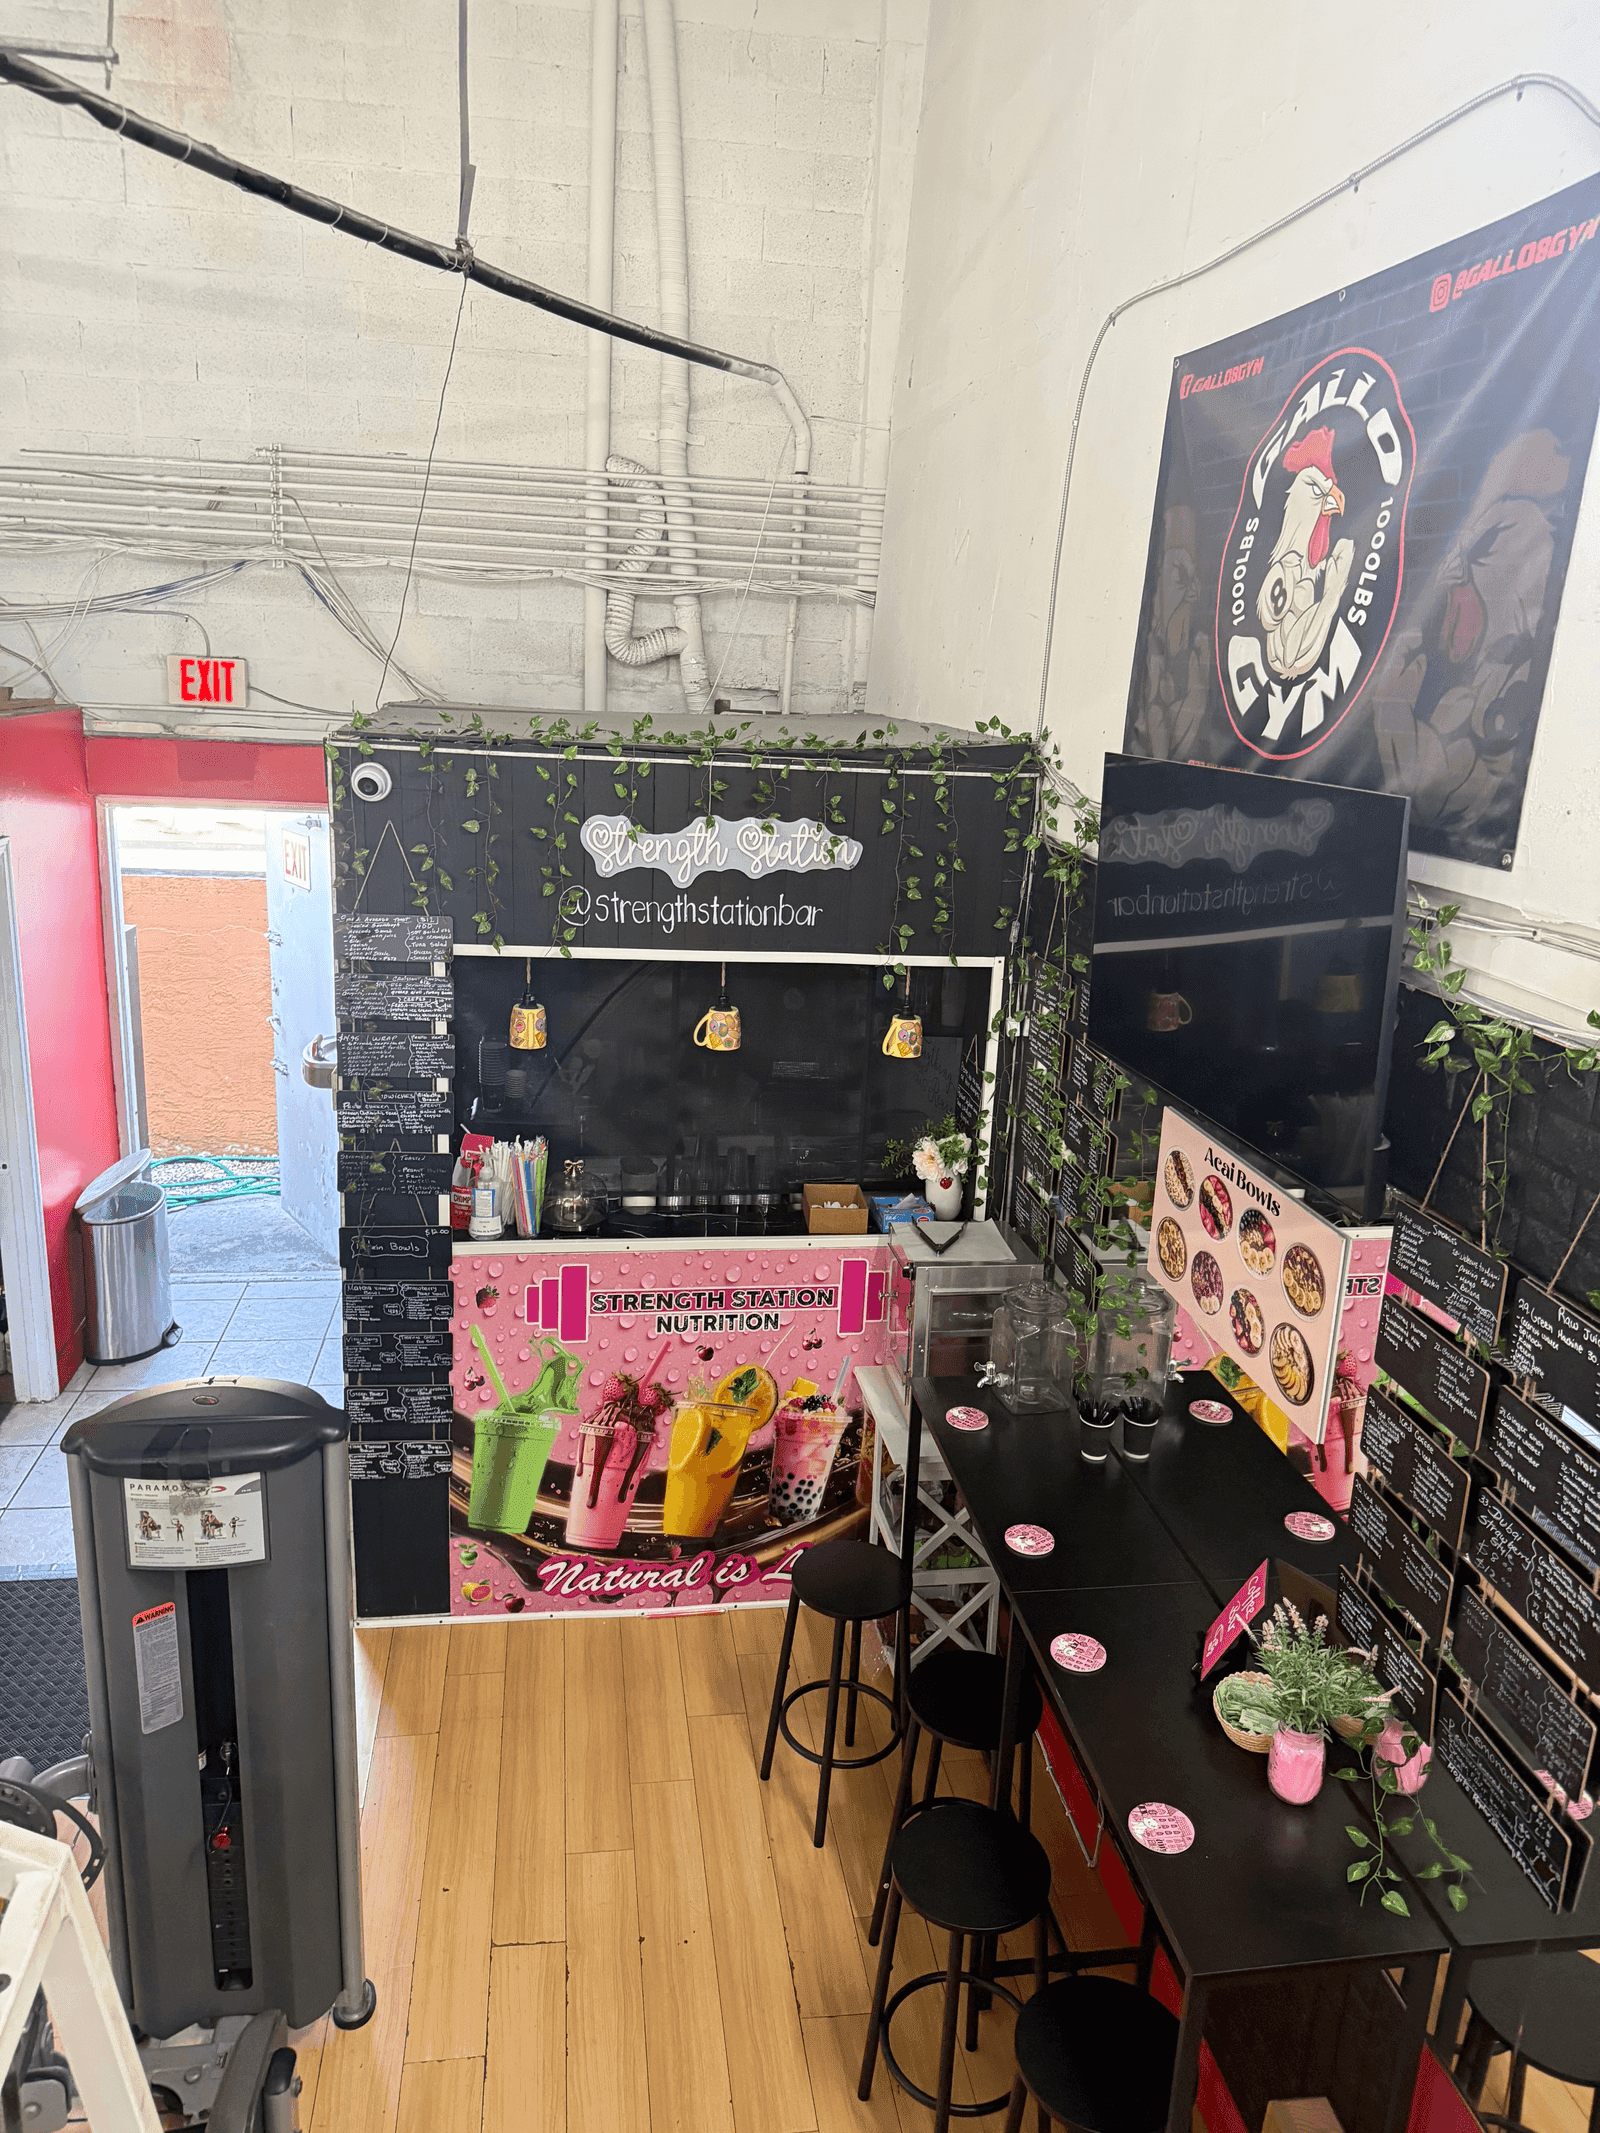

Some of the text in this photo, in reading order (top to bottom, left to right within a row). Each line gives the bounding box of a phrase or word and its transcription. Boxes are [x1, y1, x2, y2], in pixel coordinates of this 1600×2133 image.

[1253, 368, 1403, 510] GALLO
[1231, 516, 1260, 627] 1000LBS
[1347, 496, 1395, 627] 1000LBS
[180, 658, 236, 703] EXIT
[1227, 616, 1363, 741] GYM
[284, 838, 307, 882] EXIT
[585, 819, 729, 884] Strength
[1203, 1147, 1281, 1217] Acai Bowls
[389, 1242, 420, 1252] Bowls
[591, 1287, 835, 1313] STRENGTH STATION
[1530, 1307, 1554, 1334] Green
[1557, 1304, 1579, 1331] Raw
[656, 1312, 780, 1334] NUTRITION
[1398, 1414, 1434, 1455] Iced Coffee
[1487, 1503, 1524, 1541] Dubai
[1479, 1515, 1532, 1574] Strawberry
[539, 1557, 748, 1595] Natural is
[1240, 1575, 1262, 1620] Coffee
[144, 1604, 175, 1622] WARNING
